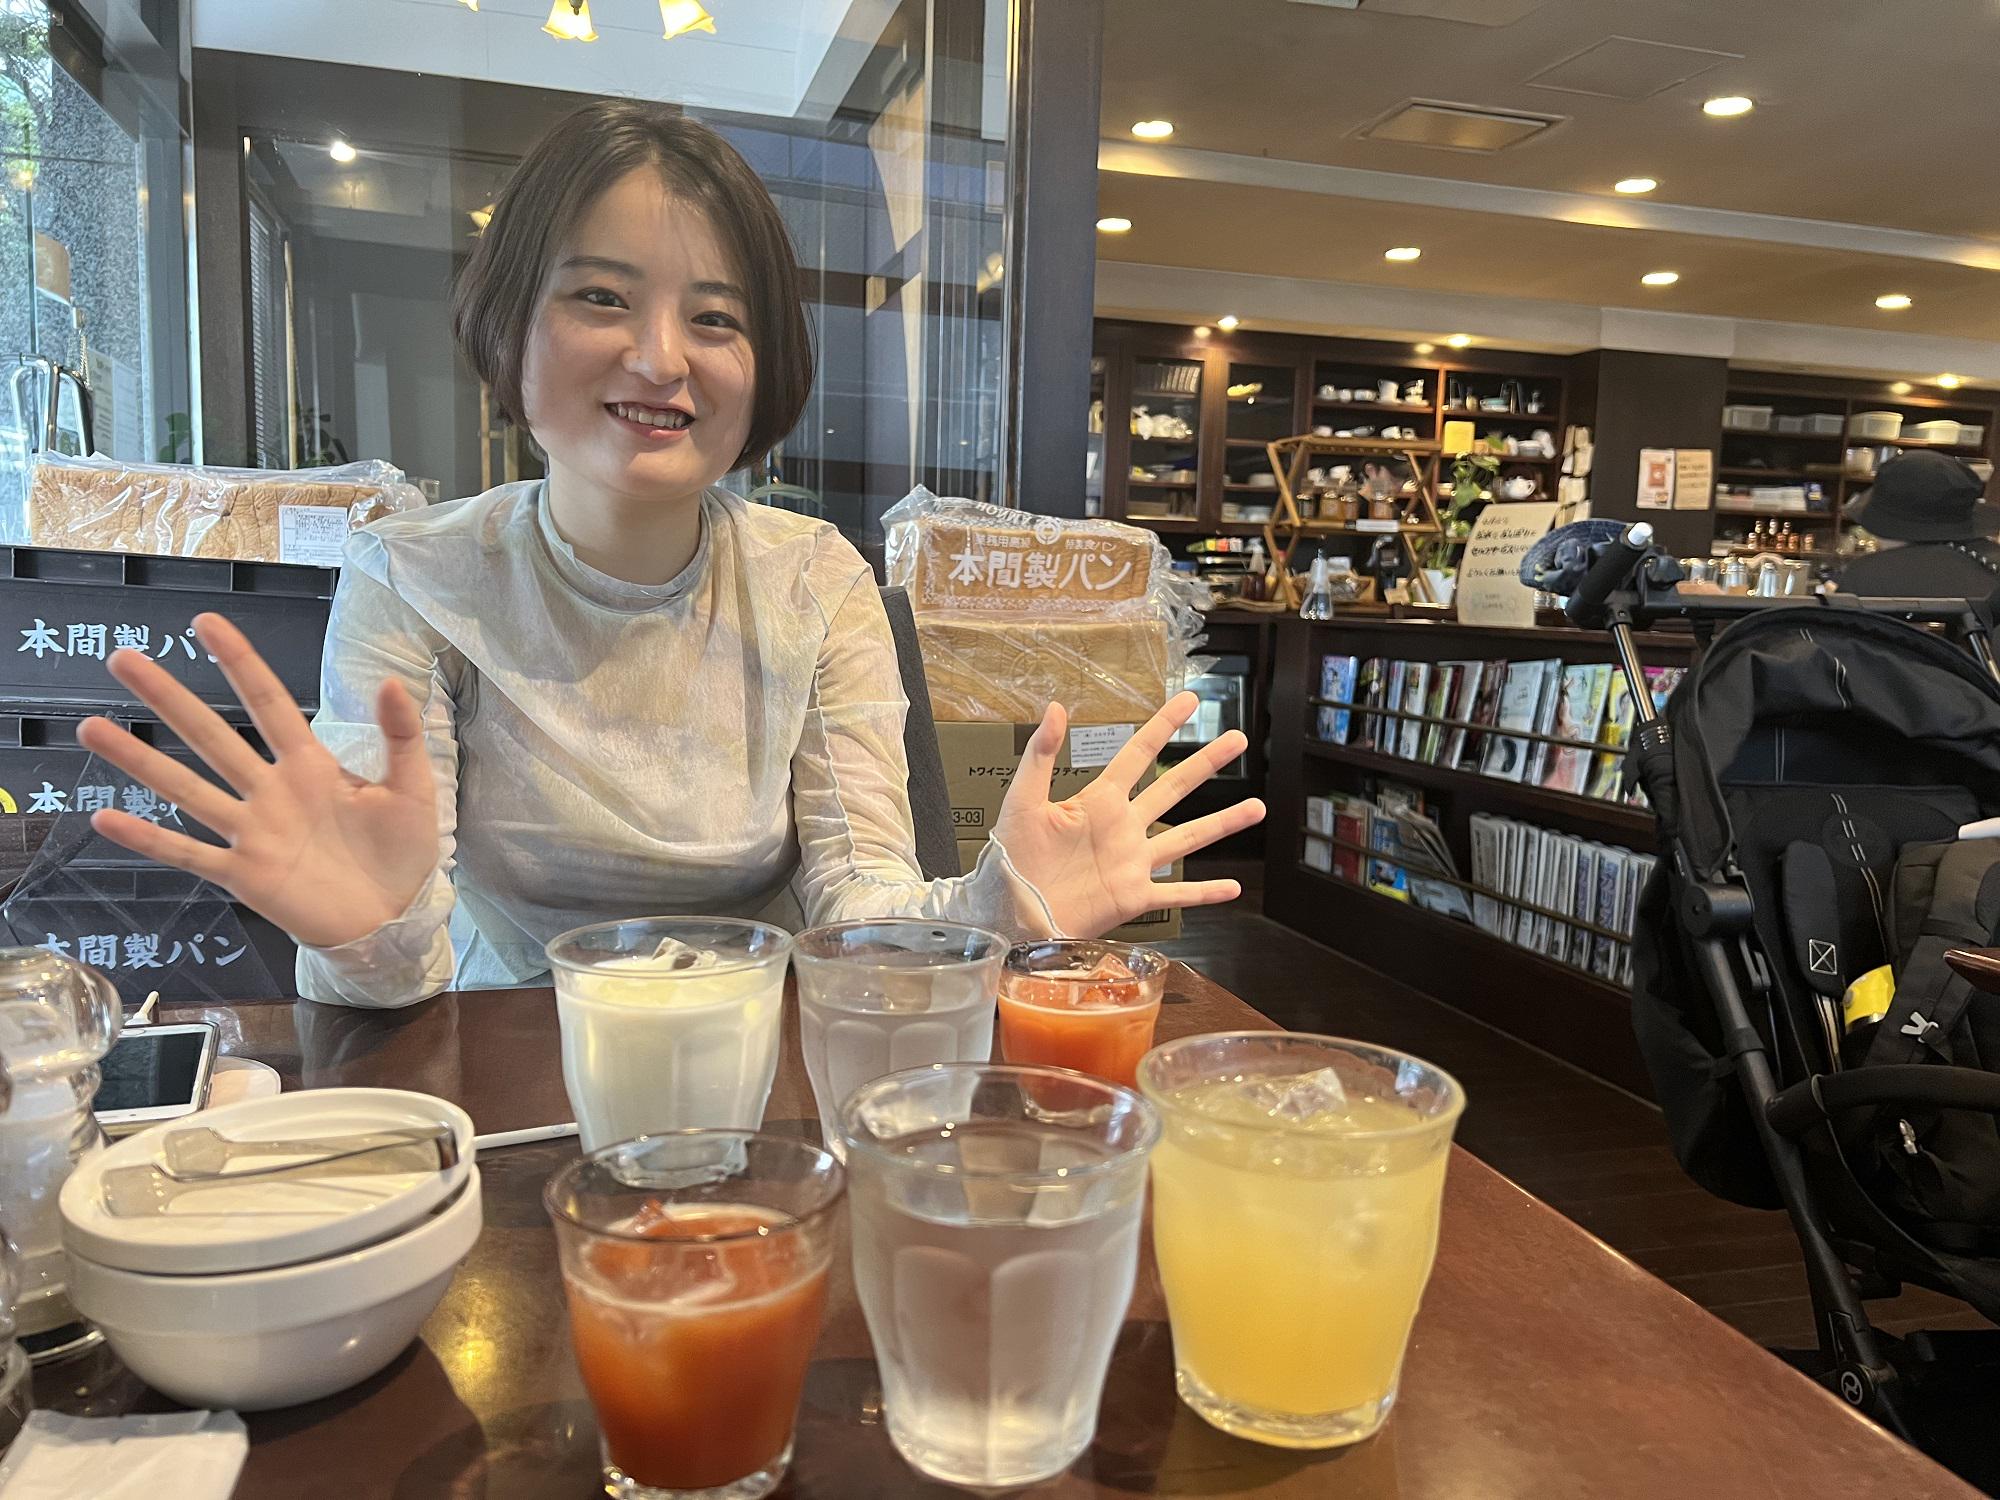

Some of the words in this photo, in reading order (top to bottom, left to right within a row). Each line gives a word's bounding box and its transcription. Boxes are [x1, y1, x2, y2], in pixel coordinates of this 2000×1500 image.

[948, 548, 1132, 590] 本間製パン
[17, 618, 219, 663] 本間製パ
[968, 766, 1017, 776] トワイニン
